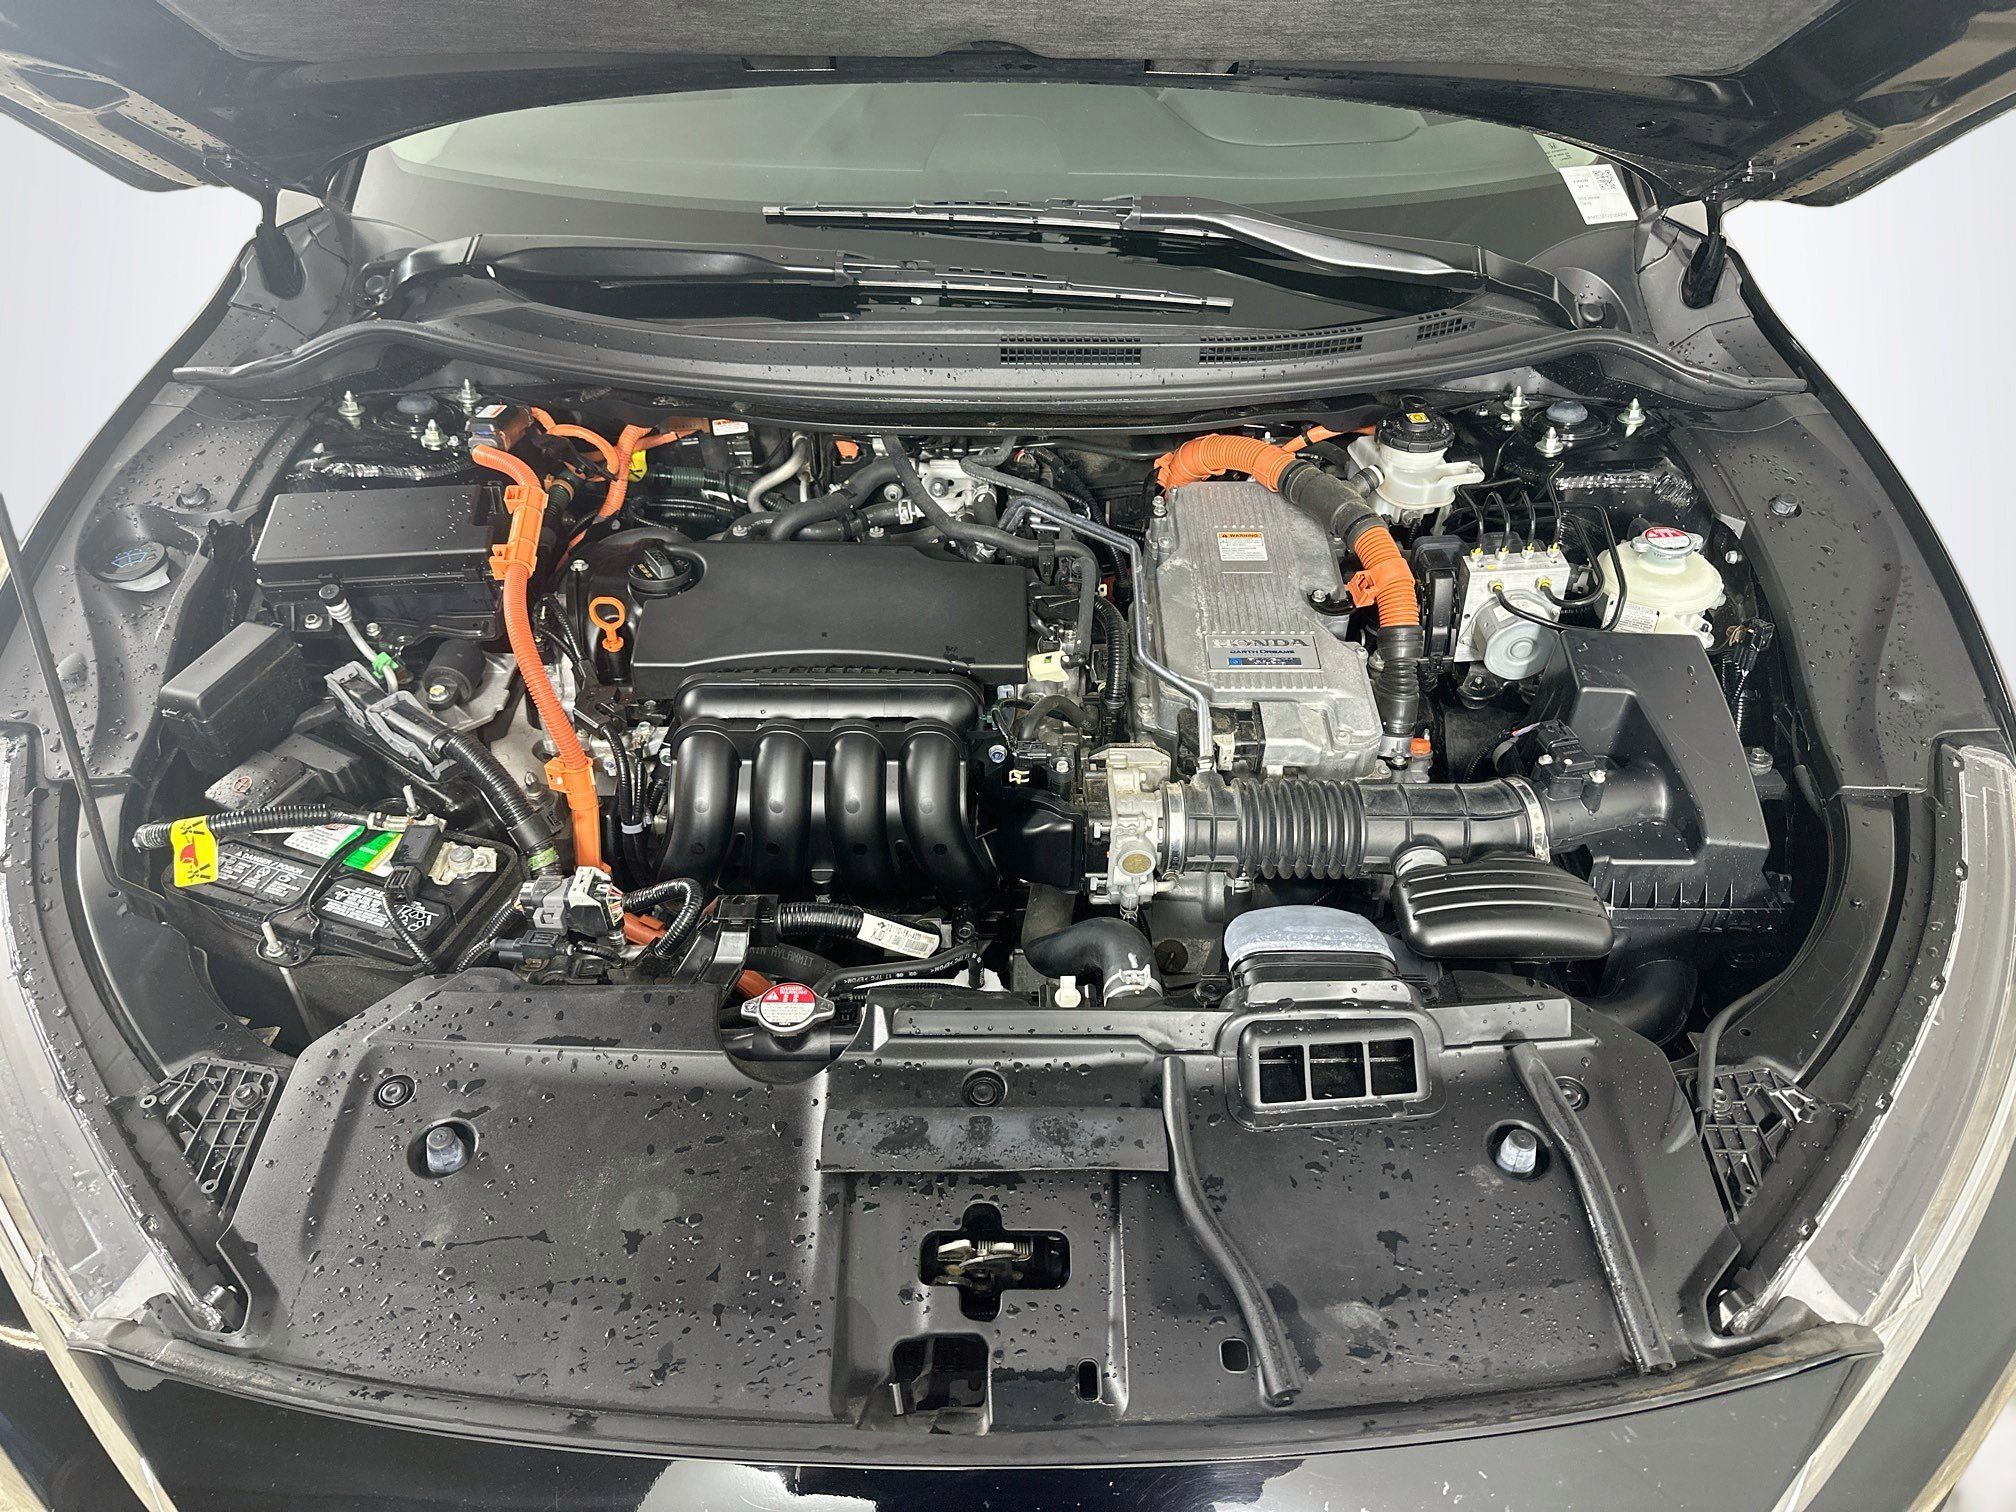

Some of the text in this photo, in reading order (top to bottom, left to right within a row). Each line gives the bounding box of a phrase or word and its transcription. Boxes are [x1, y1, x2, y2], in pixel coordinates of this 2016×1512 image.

[1213, 638, 1310, 648] HONDA
[242, 852, 273, 866] DANGER
[278, 862, 305, 875] POISON
